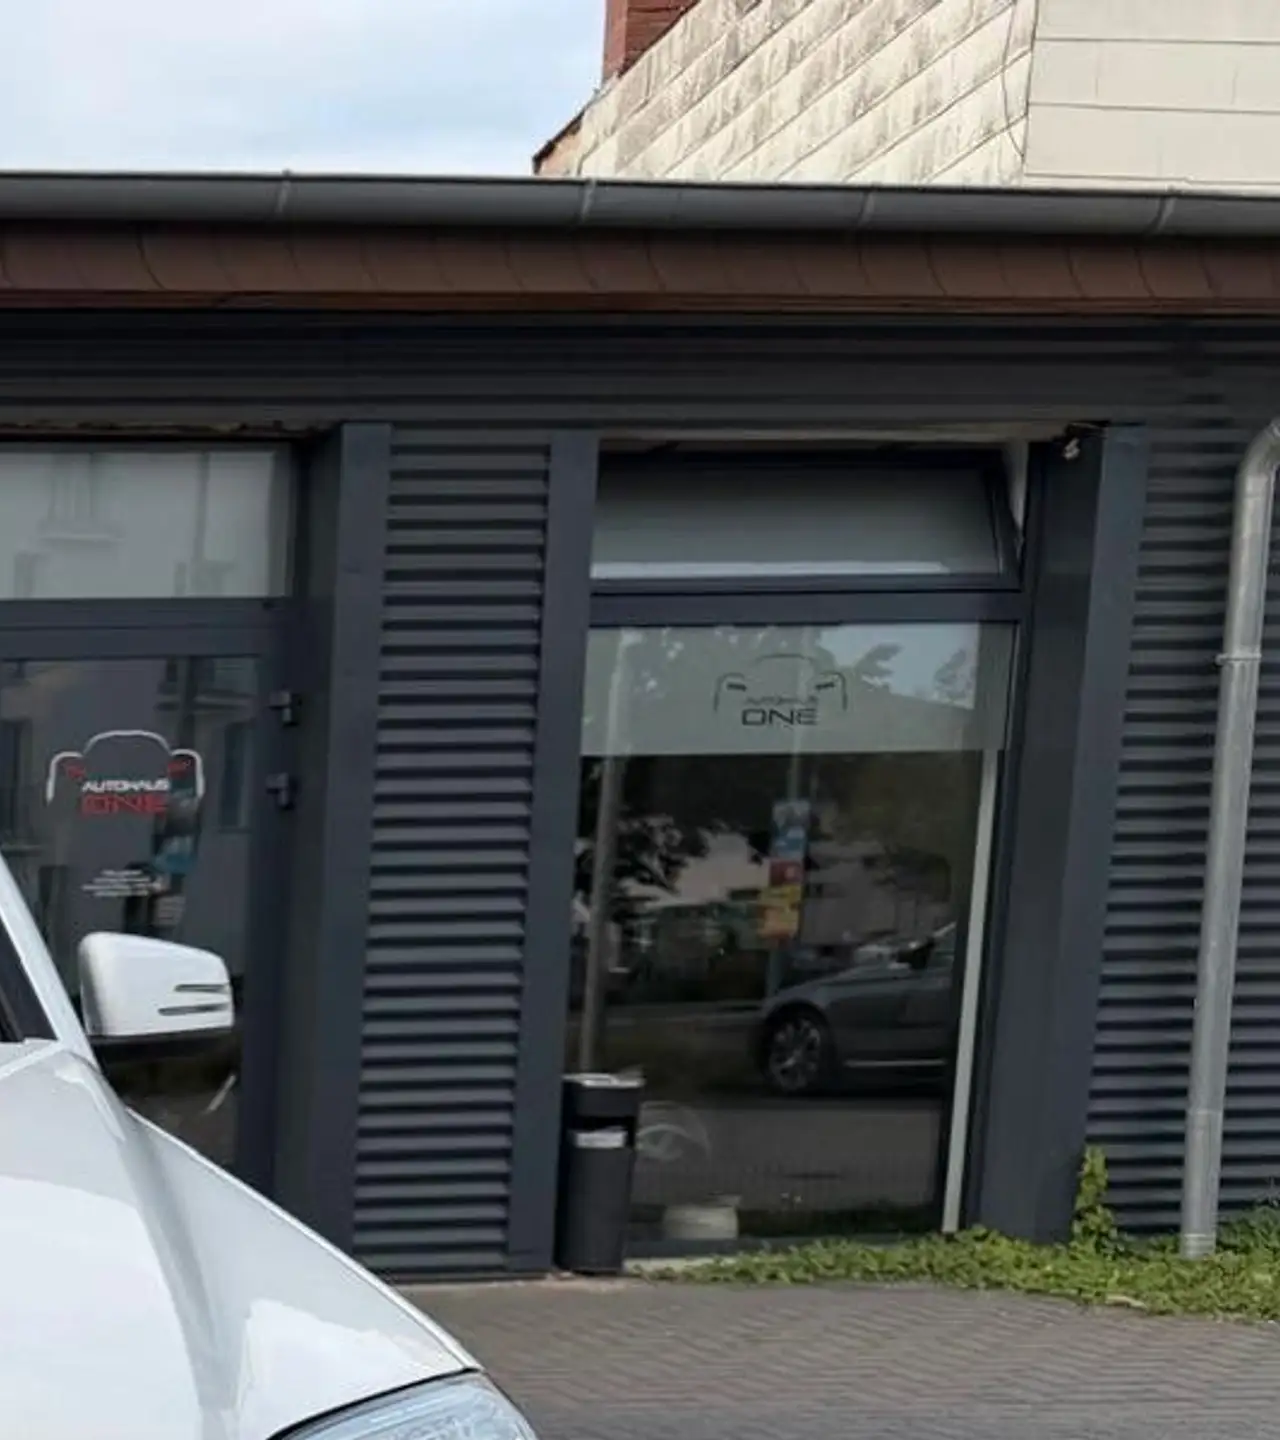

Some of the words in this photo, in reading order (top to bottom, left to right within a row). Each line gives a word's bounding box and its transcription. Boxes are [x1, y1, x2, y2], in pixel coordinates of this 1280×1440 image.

[742, 708, 817, 726] ONE
[81, 779, 170, 793] AUTOHAUS
[81, 793, 168, 815] ONE
